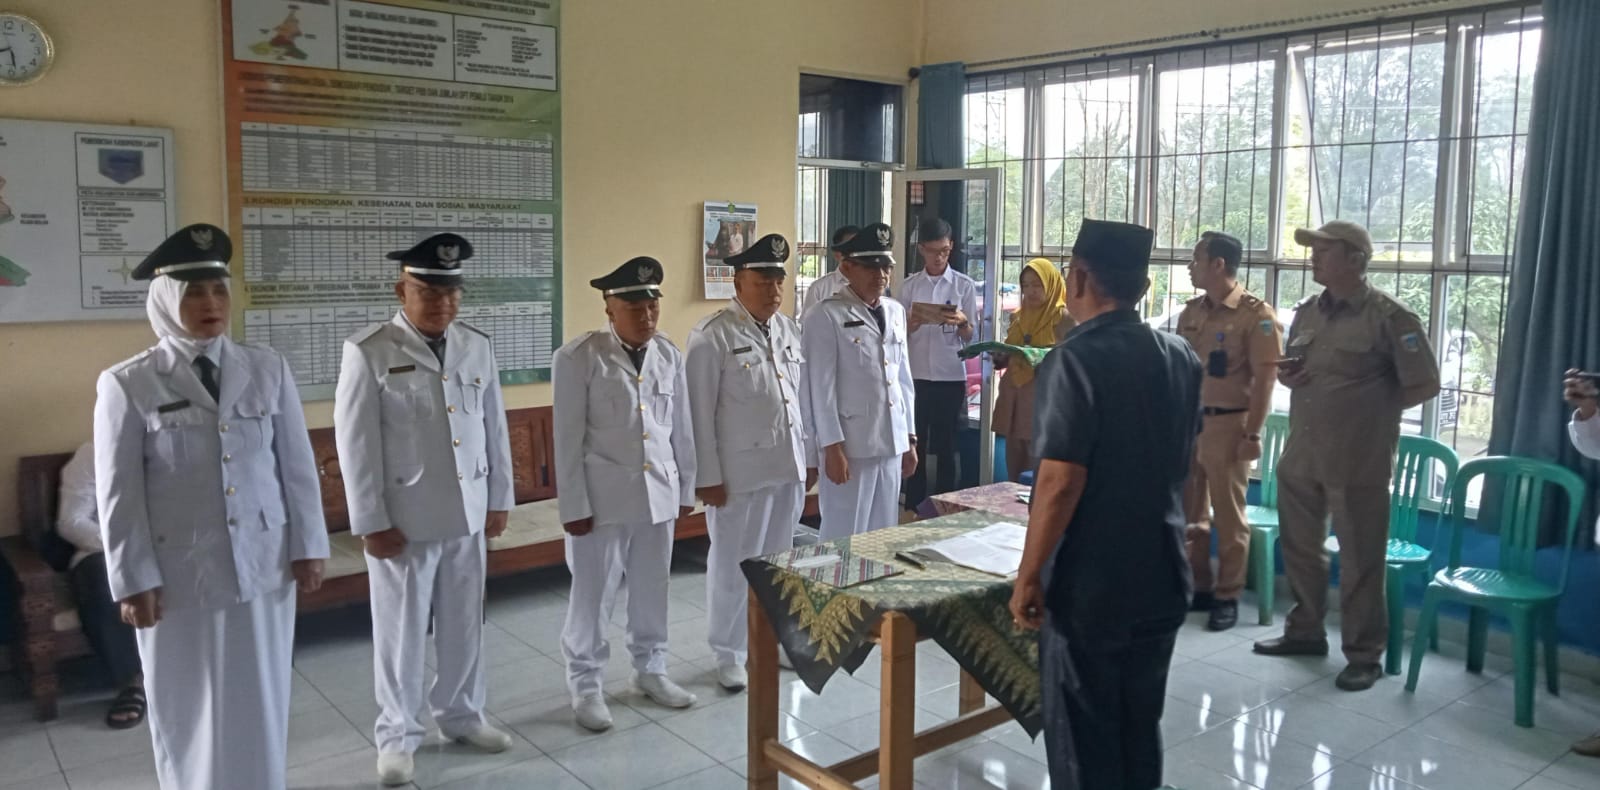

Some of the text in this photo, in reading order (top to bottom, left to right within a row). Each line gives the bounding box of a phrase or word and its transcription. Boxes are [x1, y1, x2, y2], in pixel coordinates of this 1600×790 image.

[4, 21, 14, 30] 12
[21, 24, 24, 32] 1
[29, 33, 37, 43] 2
[34, 47, 41, 55] 3
[29, 58, 37, 66] 4
[358, 198, 413, 208] KESEHATAN,
[416, 200, 433, 209] DAN
[468, 202, 521, 210] MASYARAKAT
